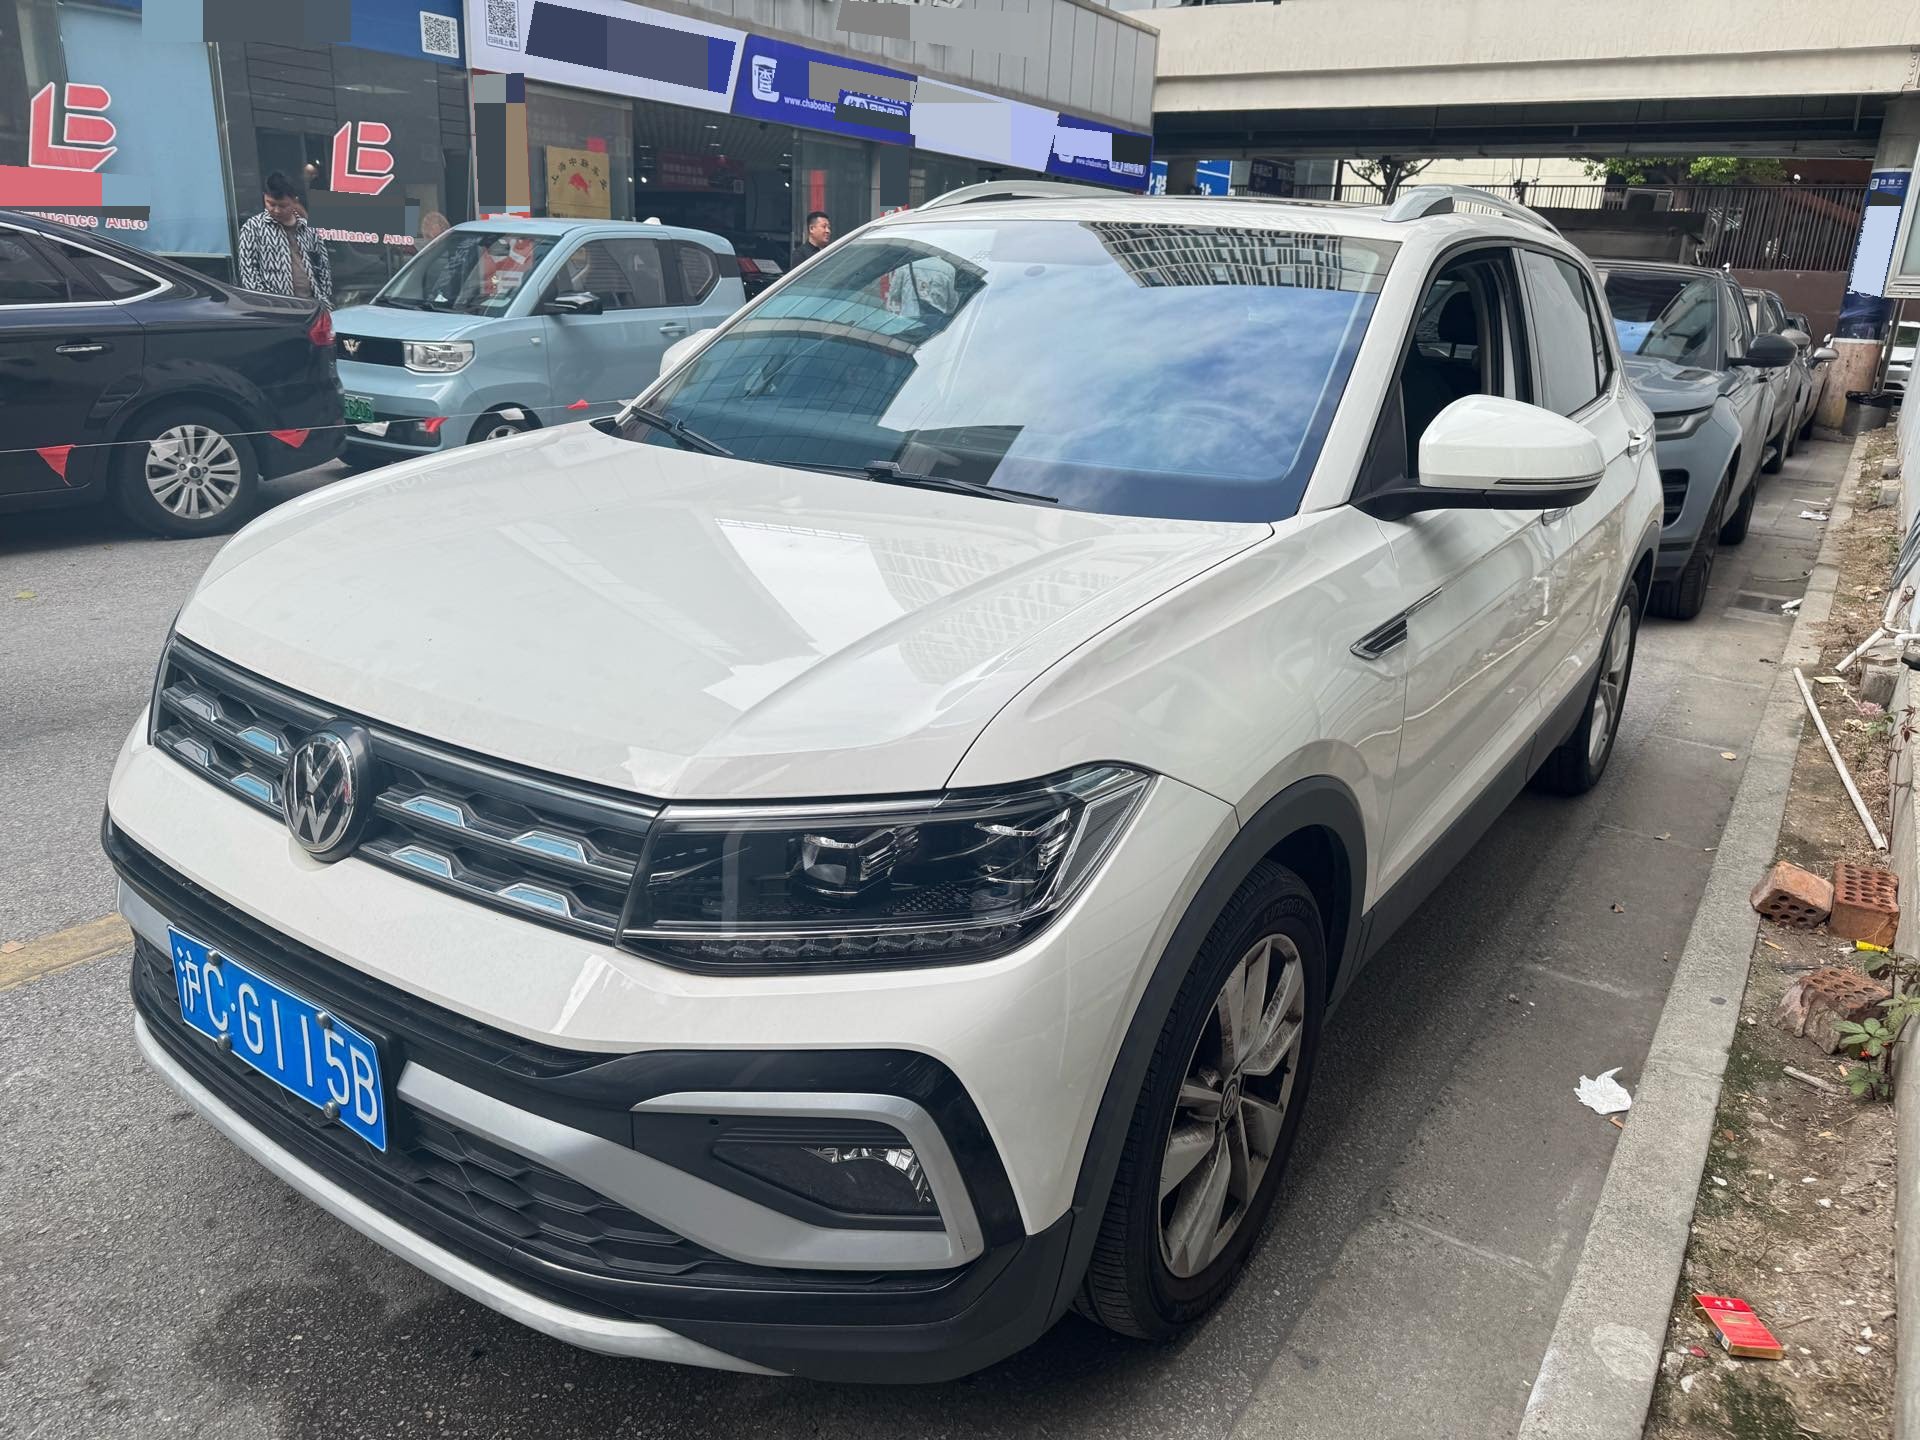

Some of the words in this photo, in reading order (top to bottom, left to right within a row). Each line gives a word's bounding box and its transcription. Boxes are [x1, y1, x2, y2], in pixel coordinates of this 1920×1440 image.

[105, 217, 148, 231] Auto
[316, 228, 379, 243] Brilliance
[383, 233, 415, 246] Auto
